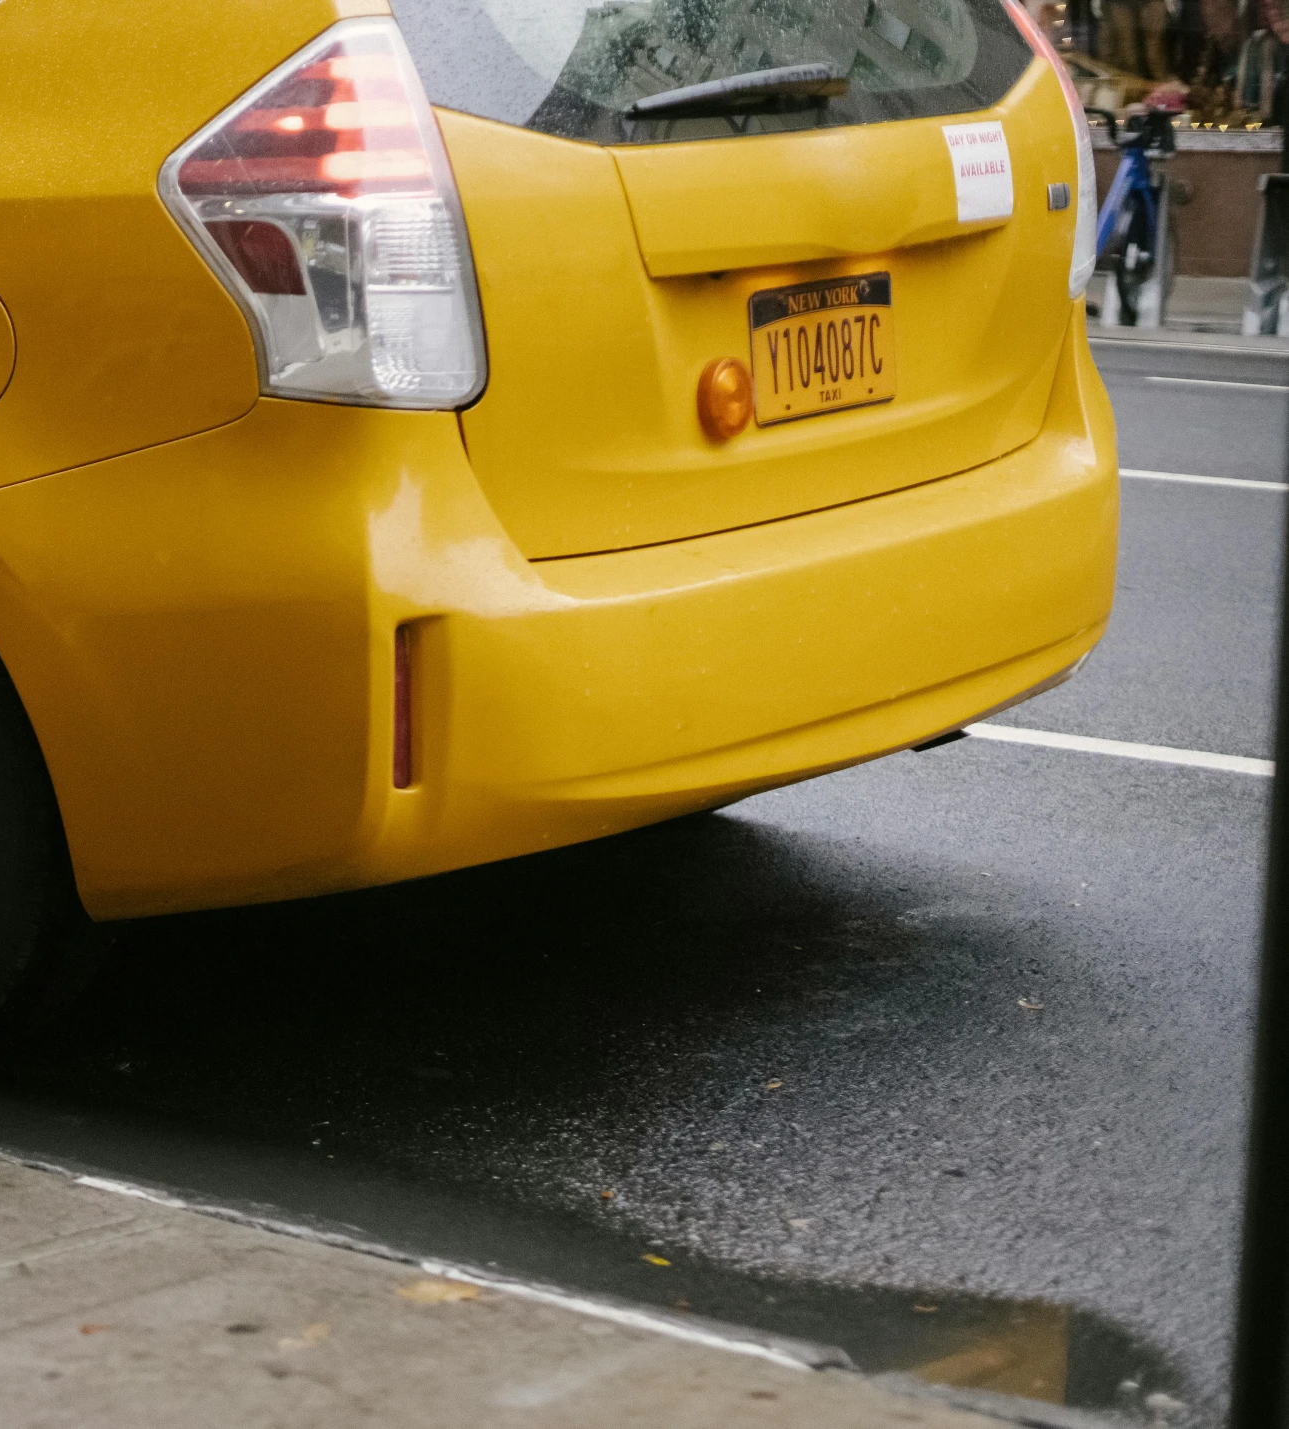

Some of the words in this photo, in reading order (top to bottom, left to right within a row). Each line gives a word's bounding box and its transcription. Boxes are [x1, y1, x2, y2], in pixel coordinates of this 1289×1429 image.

[948, 134, 964, 147] DAY
[966, 132, 978, 145] OR
[979, 131, 1003, 144] NIGHT
[960, 160, 1006, 178] AVAILABLE
[788, 291, 822, 314] NEW
[824, 285, 859, 307] YORK
[767, 313, 883, 394] Y104087C
[819, 387, 842, 402] TAXI
